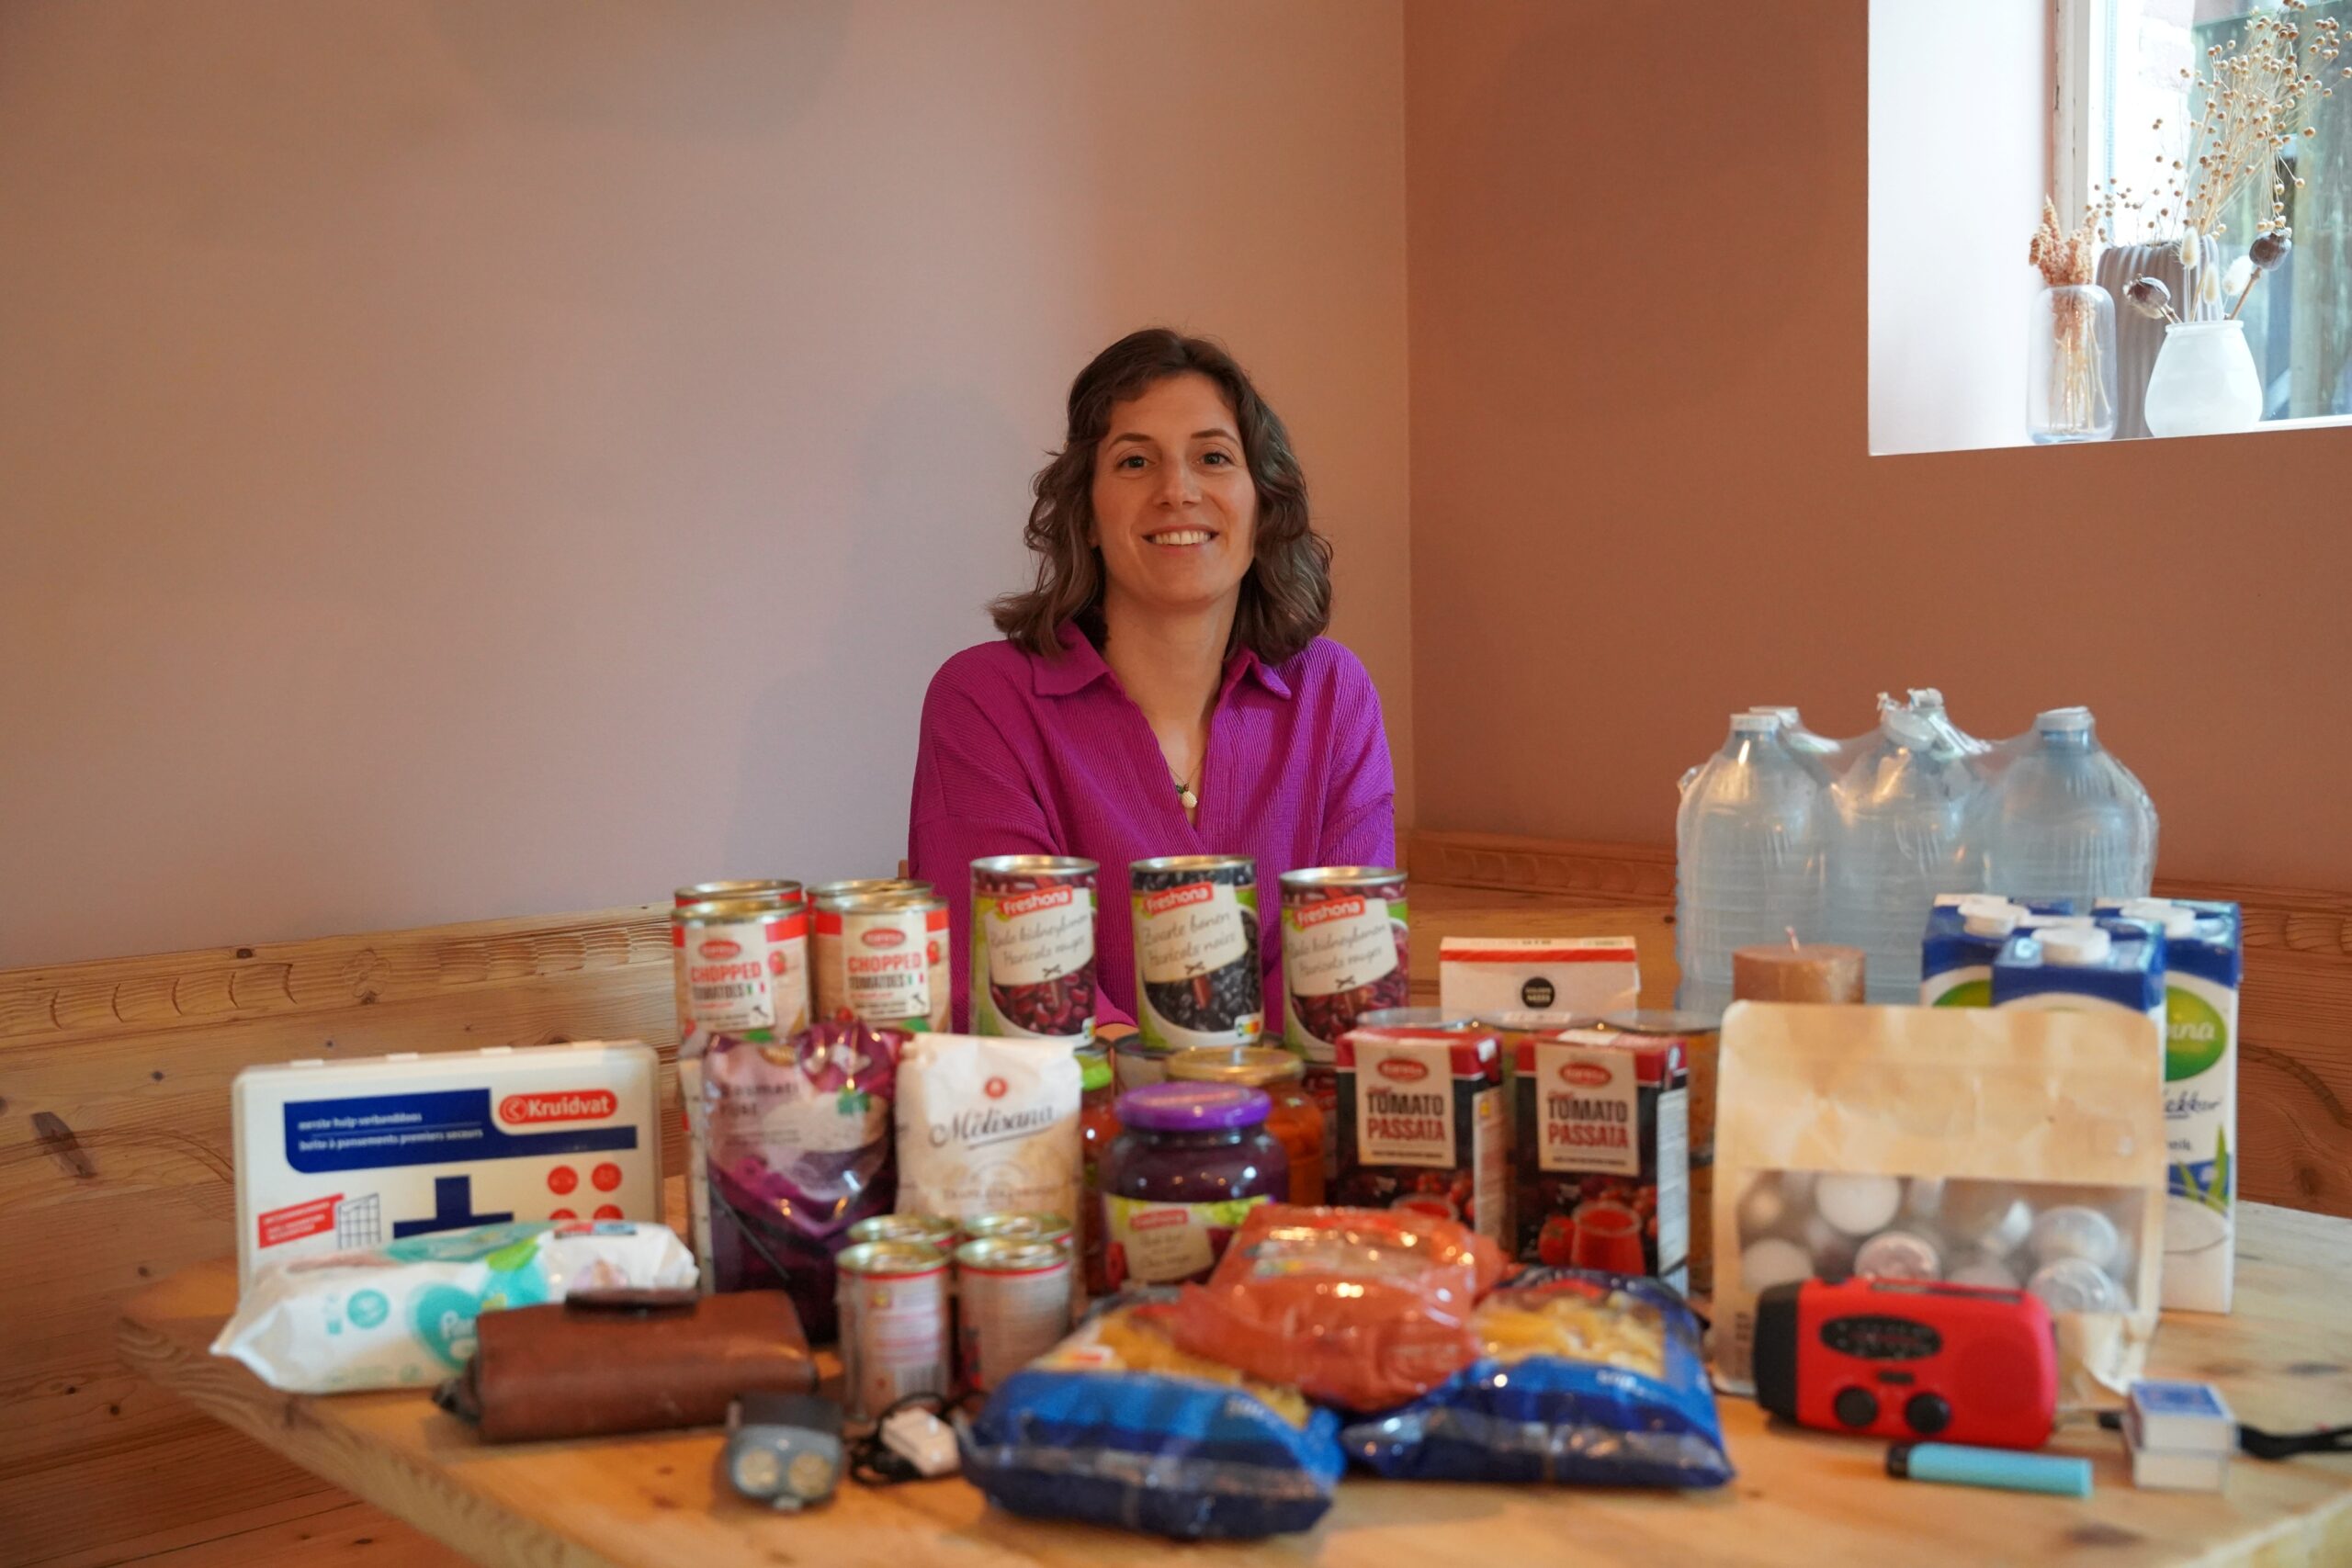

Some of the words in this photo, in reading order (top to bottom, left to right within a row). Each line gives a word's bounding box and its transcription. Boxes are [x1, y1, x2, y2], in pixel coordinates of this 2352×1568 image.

[691, 963, 761, 982] CHOPPED
[847, 953, 921, 972] CHOPPED
[527, 1095, 610, 1118] Kruidvat
[1367, 1093, 1443, 1116] TOMATO
[1548, 1098, 1628, 1122] TOMATO
[1366, 1118, 1446, 1141] PASSATA
[1547, 1122, 1630, 1148] PASSATA
